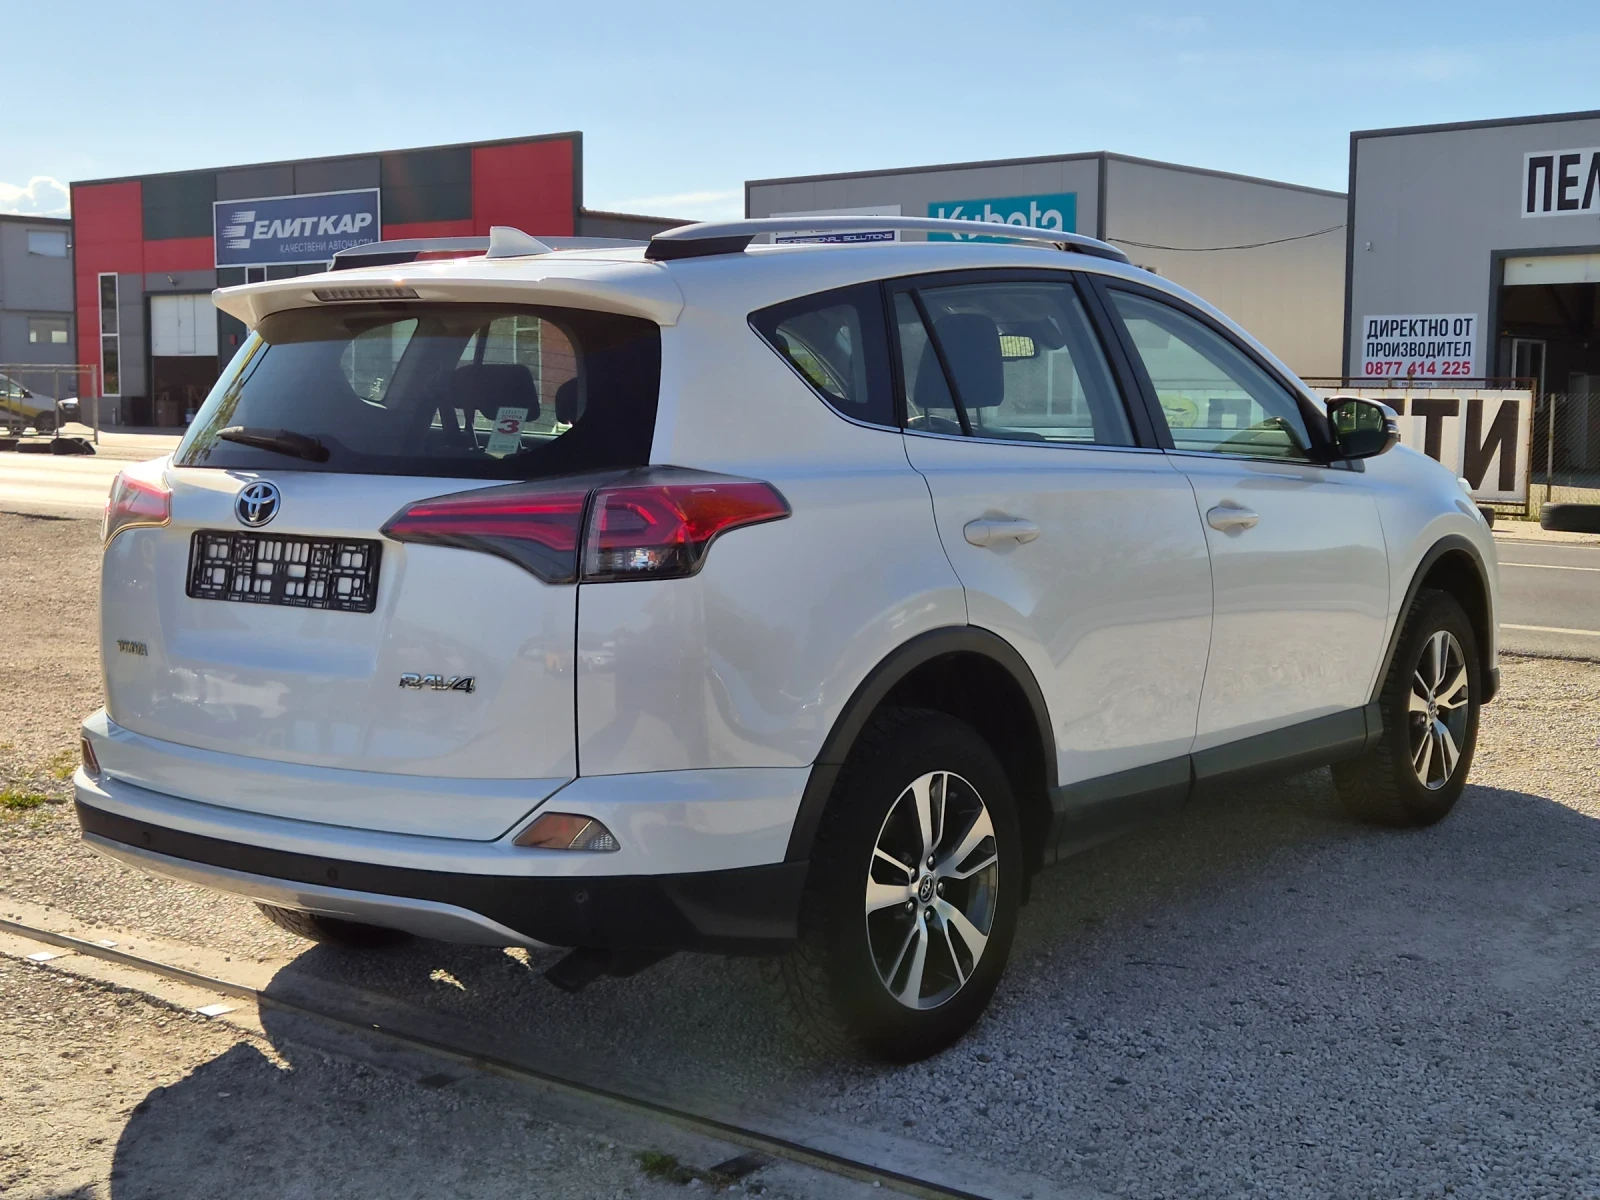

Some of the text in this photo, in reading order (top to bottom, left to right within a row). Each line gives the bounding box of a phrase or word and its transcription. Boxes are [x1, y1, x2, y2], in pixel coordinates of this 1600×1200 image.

[843, 233, 893, 241] SOLUTIONS
[280, 242, 327, 253] КАЧЕСТВЕНИ
[1367, 318, 1474, 340] ДИРЕКТНО ОТ
[1366, 341, 1472, 359] ПРОИЗВОДИТЕЛ
[1365, 361, 1471, 375] 0877 414 225
[497, 418, 520, 434] 3
[399, 672, 476, 694] RAV4
